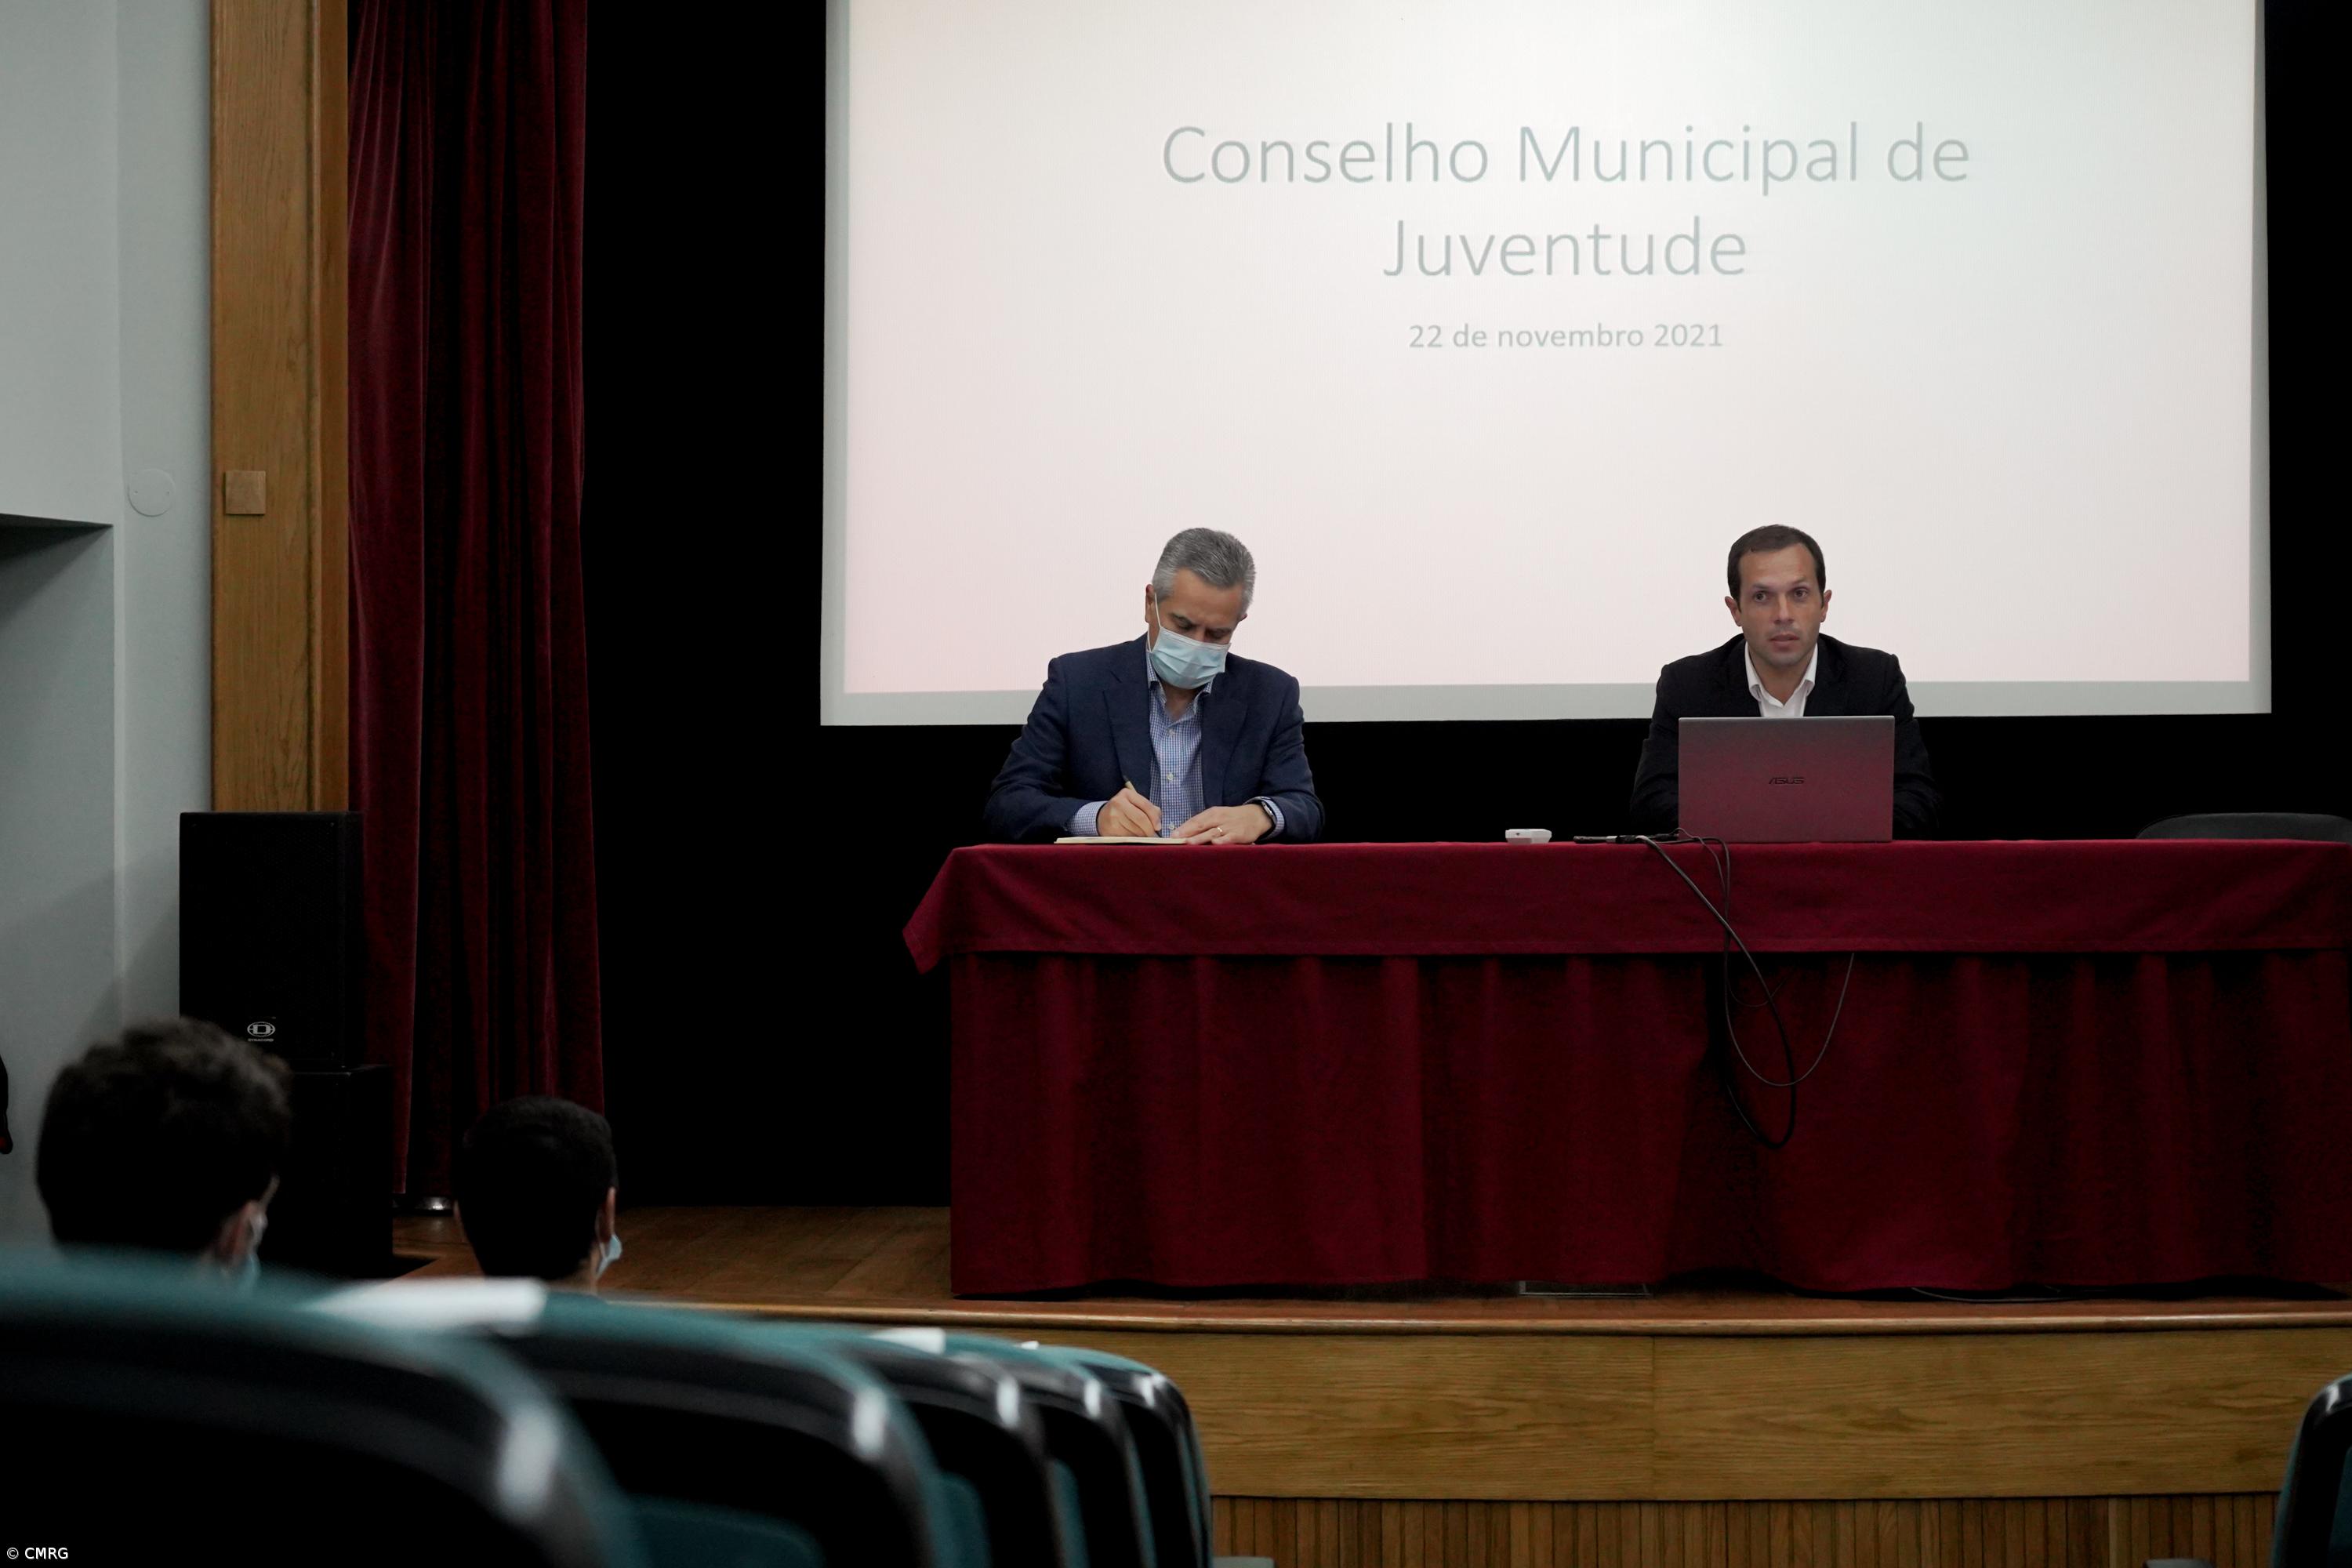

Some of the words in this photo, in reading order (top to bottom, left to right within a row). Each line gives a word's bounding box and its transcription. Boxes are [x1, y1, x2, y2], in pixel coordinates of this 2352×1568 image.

[1163, 122, 1489, 184] Conselho
[1519, 122, 1858, 196] Municipal
[1887, 122, 1971, 183] de
[1384, 216, 1747, 277] Juventude
[1409, 325, 1444, 348] 22
[1454, 324, 1488, 348] de
[1498, 323, 1645, 348] novembro
[1654, 324, 1724, 348] 2021
